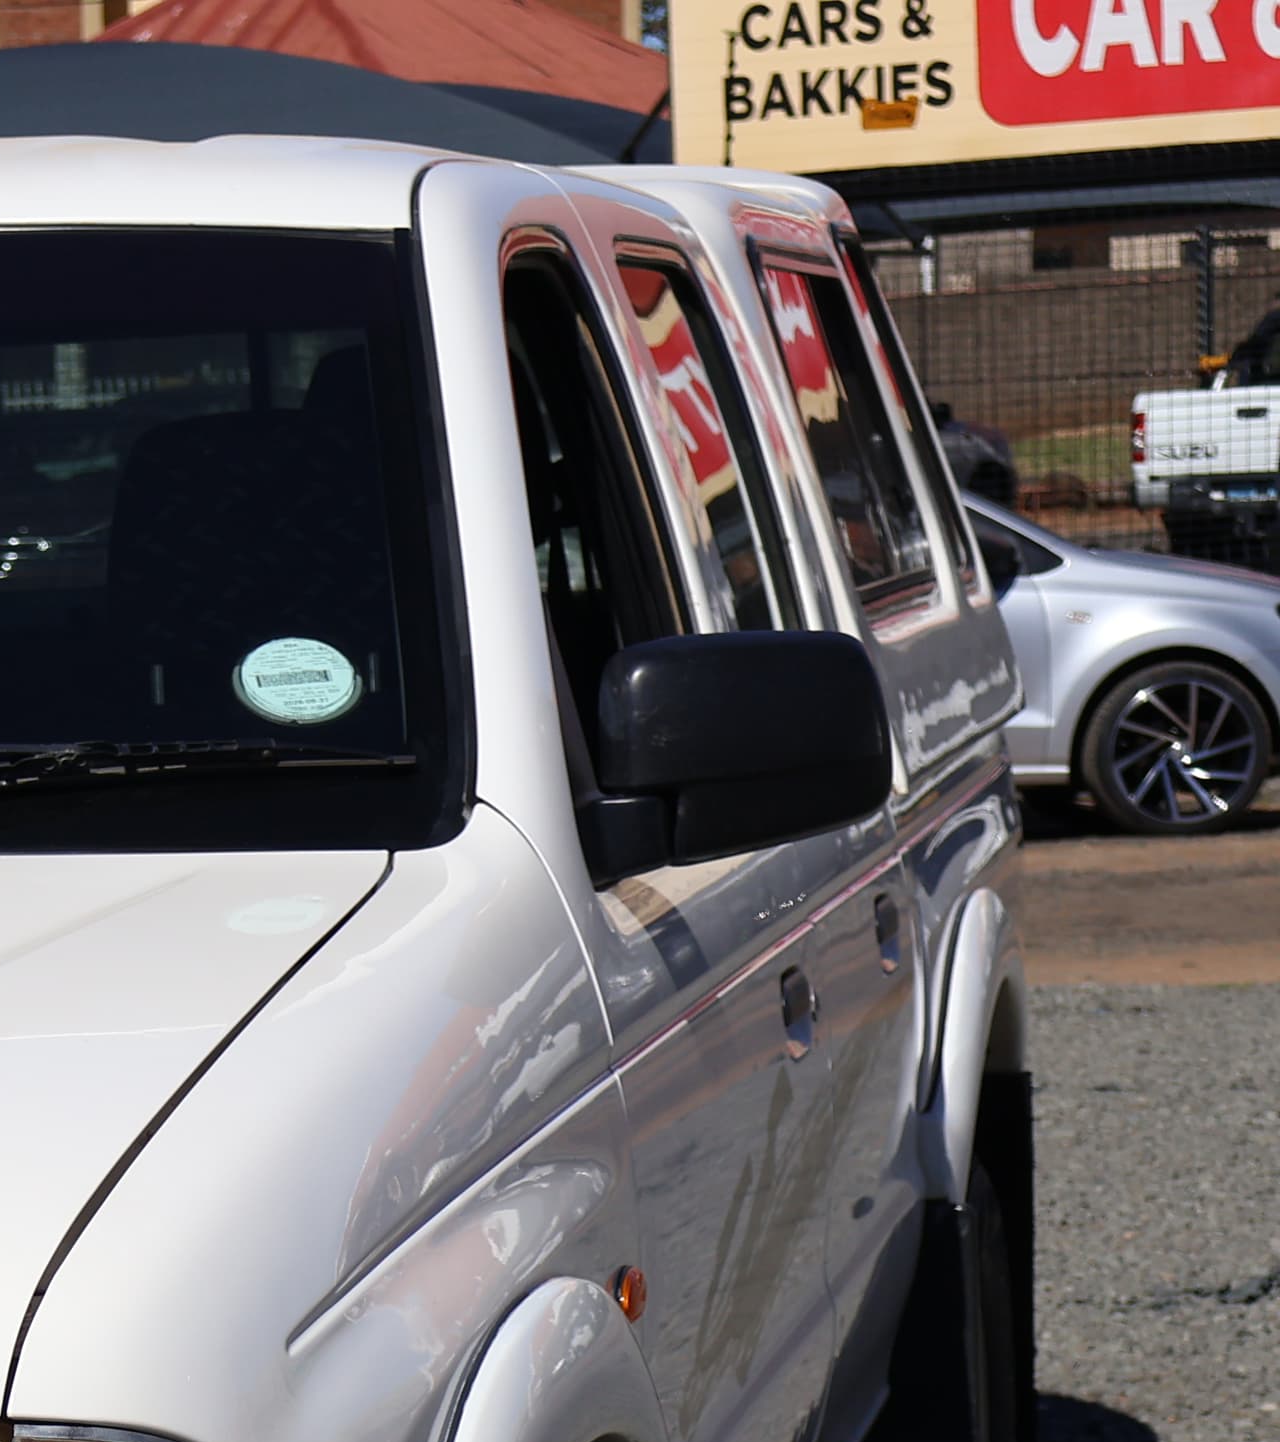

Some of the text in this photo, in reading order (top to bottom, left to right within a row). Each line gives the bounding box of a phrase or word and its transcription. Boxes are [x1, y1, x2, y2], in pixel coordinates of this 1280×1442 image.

[741, 0, 934, 49] CARS &
[725, 61, 953, 121] BAKKIES
